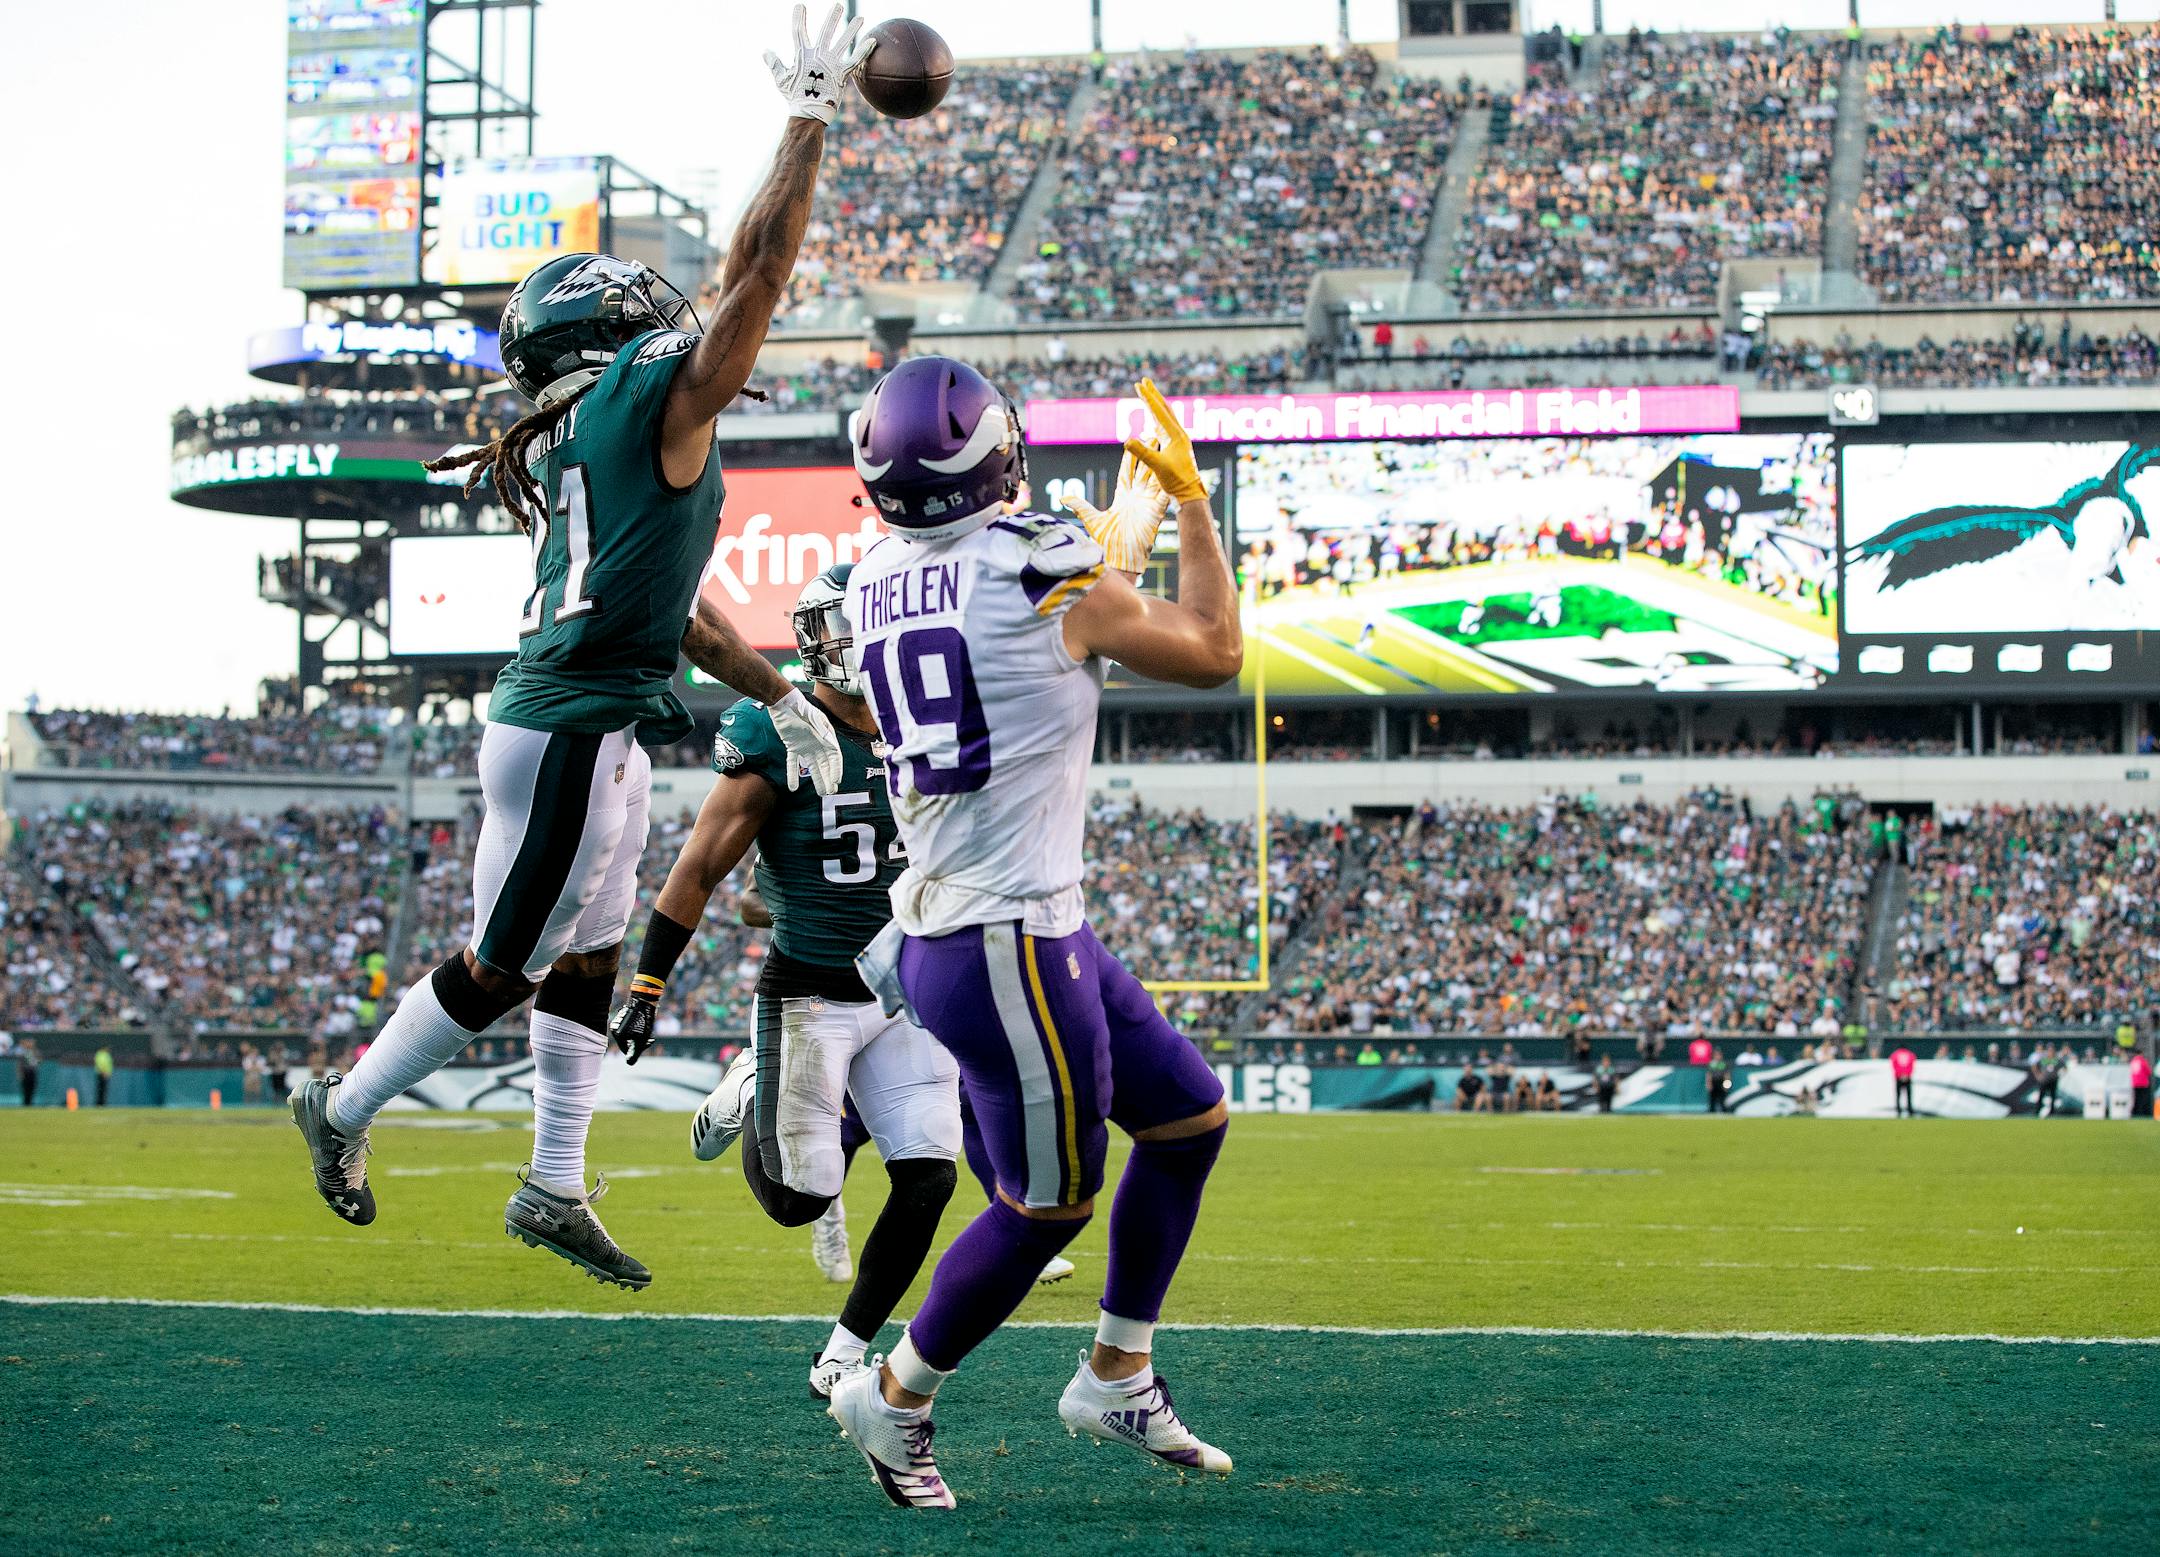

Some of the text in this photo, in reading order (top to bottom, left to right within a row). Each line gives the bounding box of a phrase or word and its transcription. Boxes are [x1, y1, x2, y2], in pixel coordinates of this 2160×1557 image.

[475, 191, 552, 217] BUD
[461, 221, 564, 249] LIGHT
[1177, 388, 1641, 440] Lincoln Financial Field
[519, 464, 599, 640] 21
[703, 513, 890, 605] xfinit
[860, 561, 960, 632] THIELEN
[858, 626, 992, 799] 19
[1215, 1064, 1312, 1113] LES
[1099, 1408, 1149, 1451] thielen
